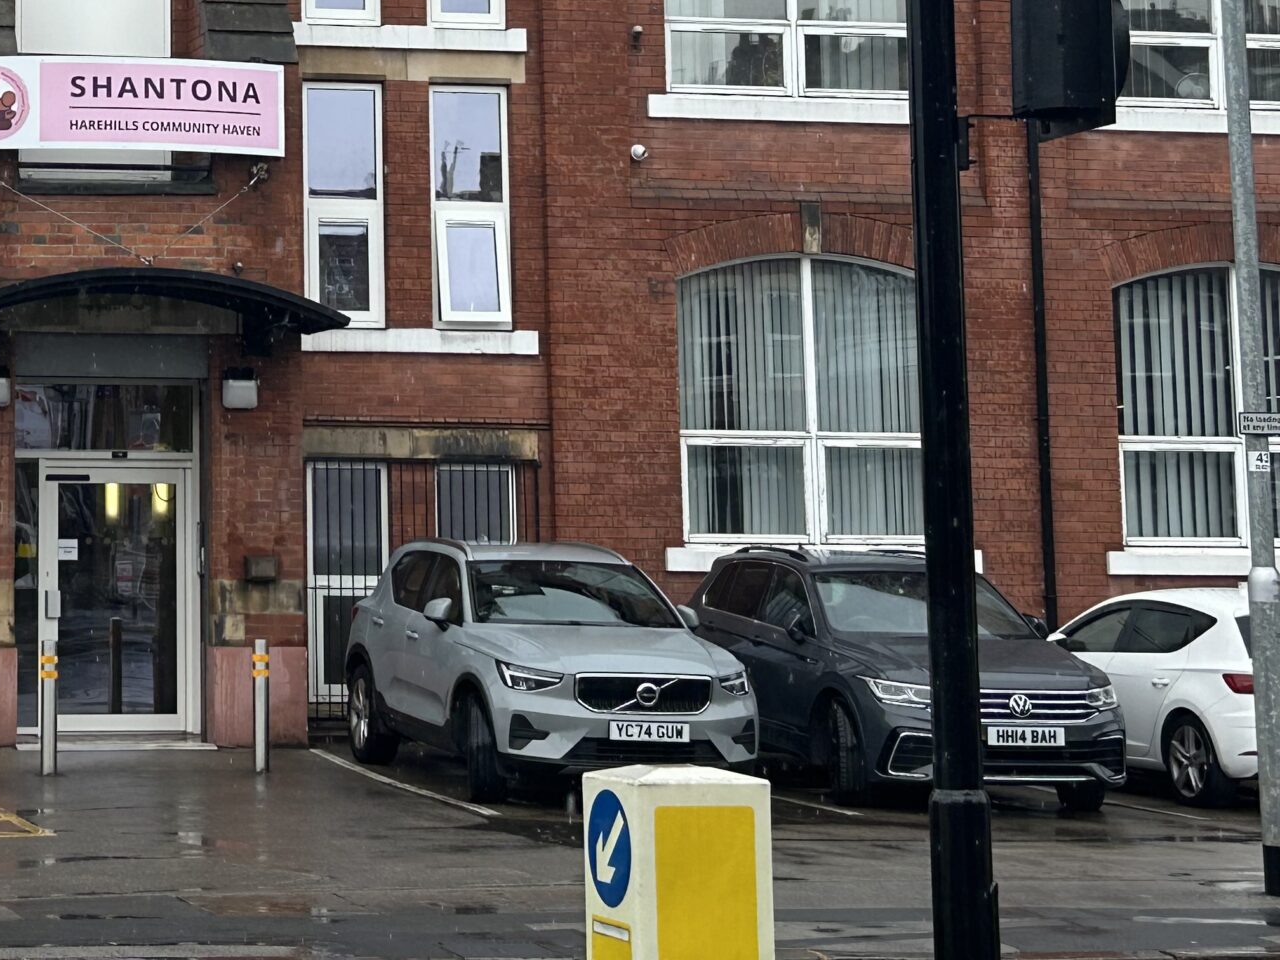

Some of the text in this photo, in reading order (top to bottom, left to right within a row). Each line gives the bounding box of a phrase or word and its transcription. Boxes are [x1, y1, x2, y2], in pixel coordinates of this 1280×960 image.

[70, 75, 261, 104] SHANTONA
[69, 119, 261, 137] HAREHILLS COMMUNITY HAVEN
[616, 723, 684, 739] YC74 GUW
[996, 729, 1057, 744] HH14 BAH
